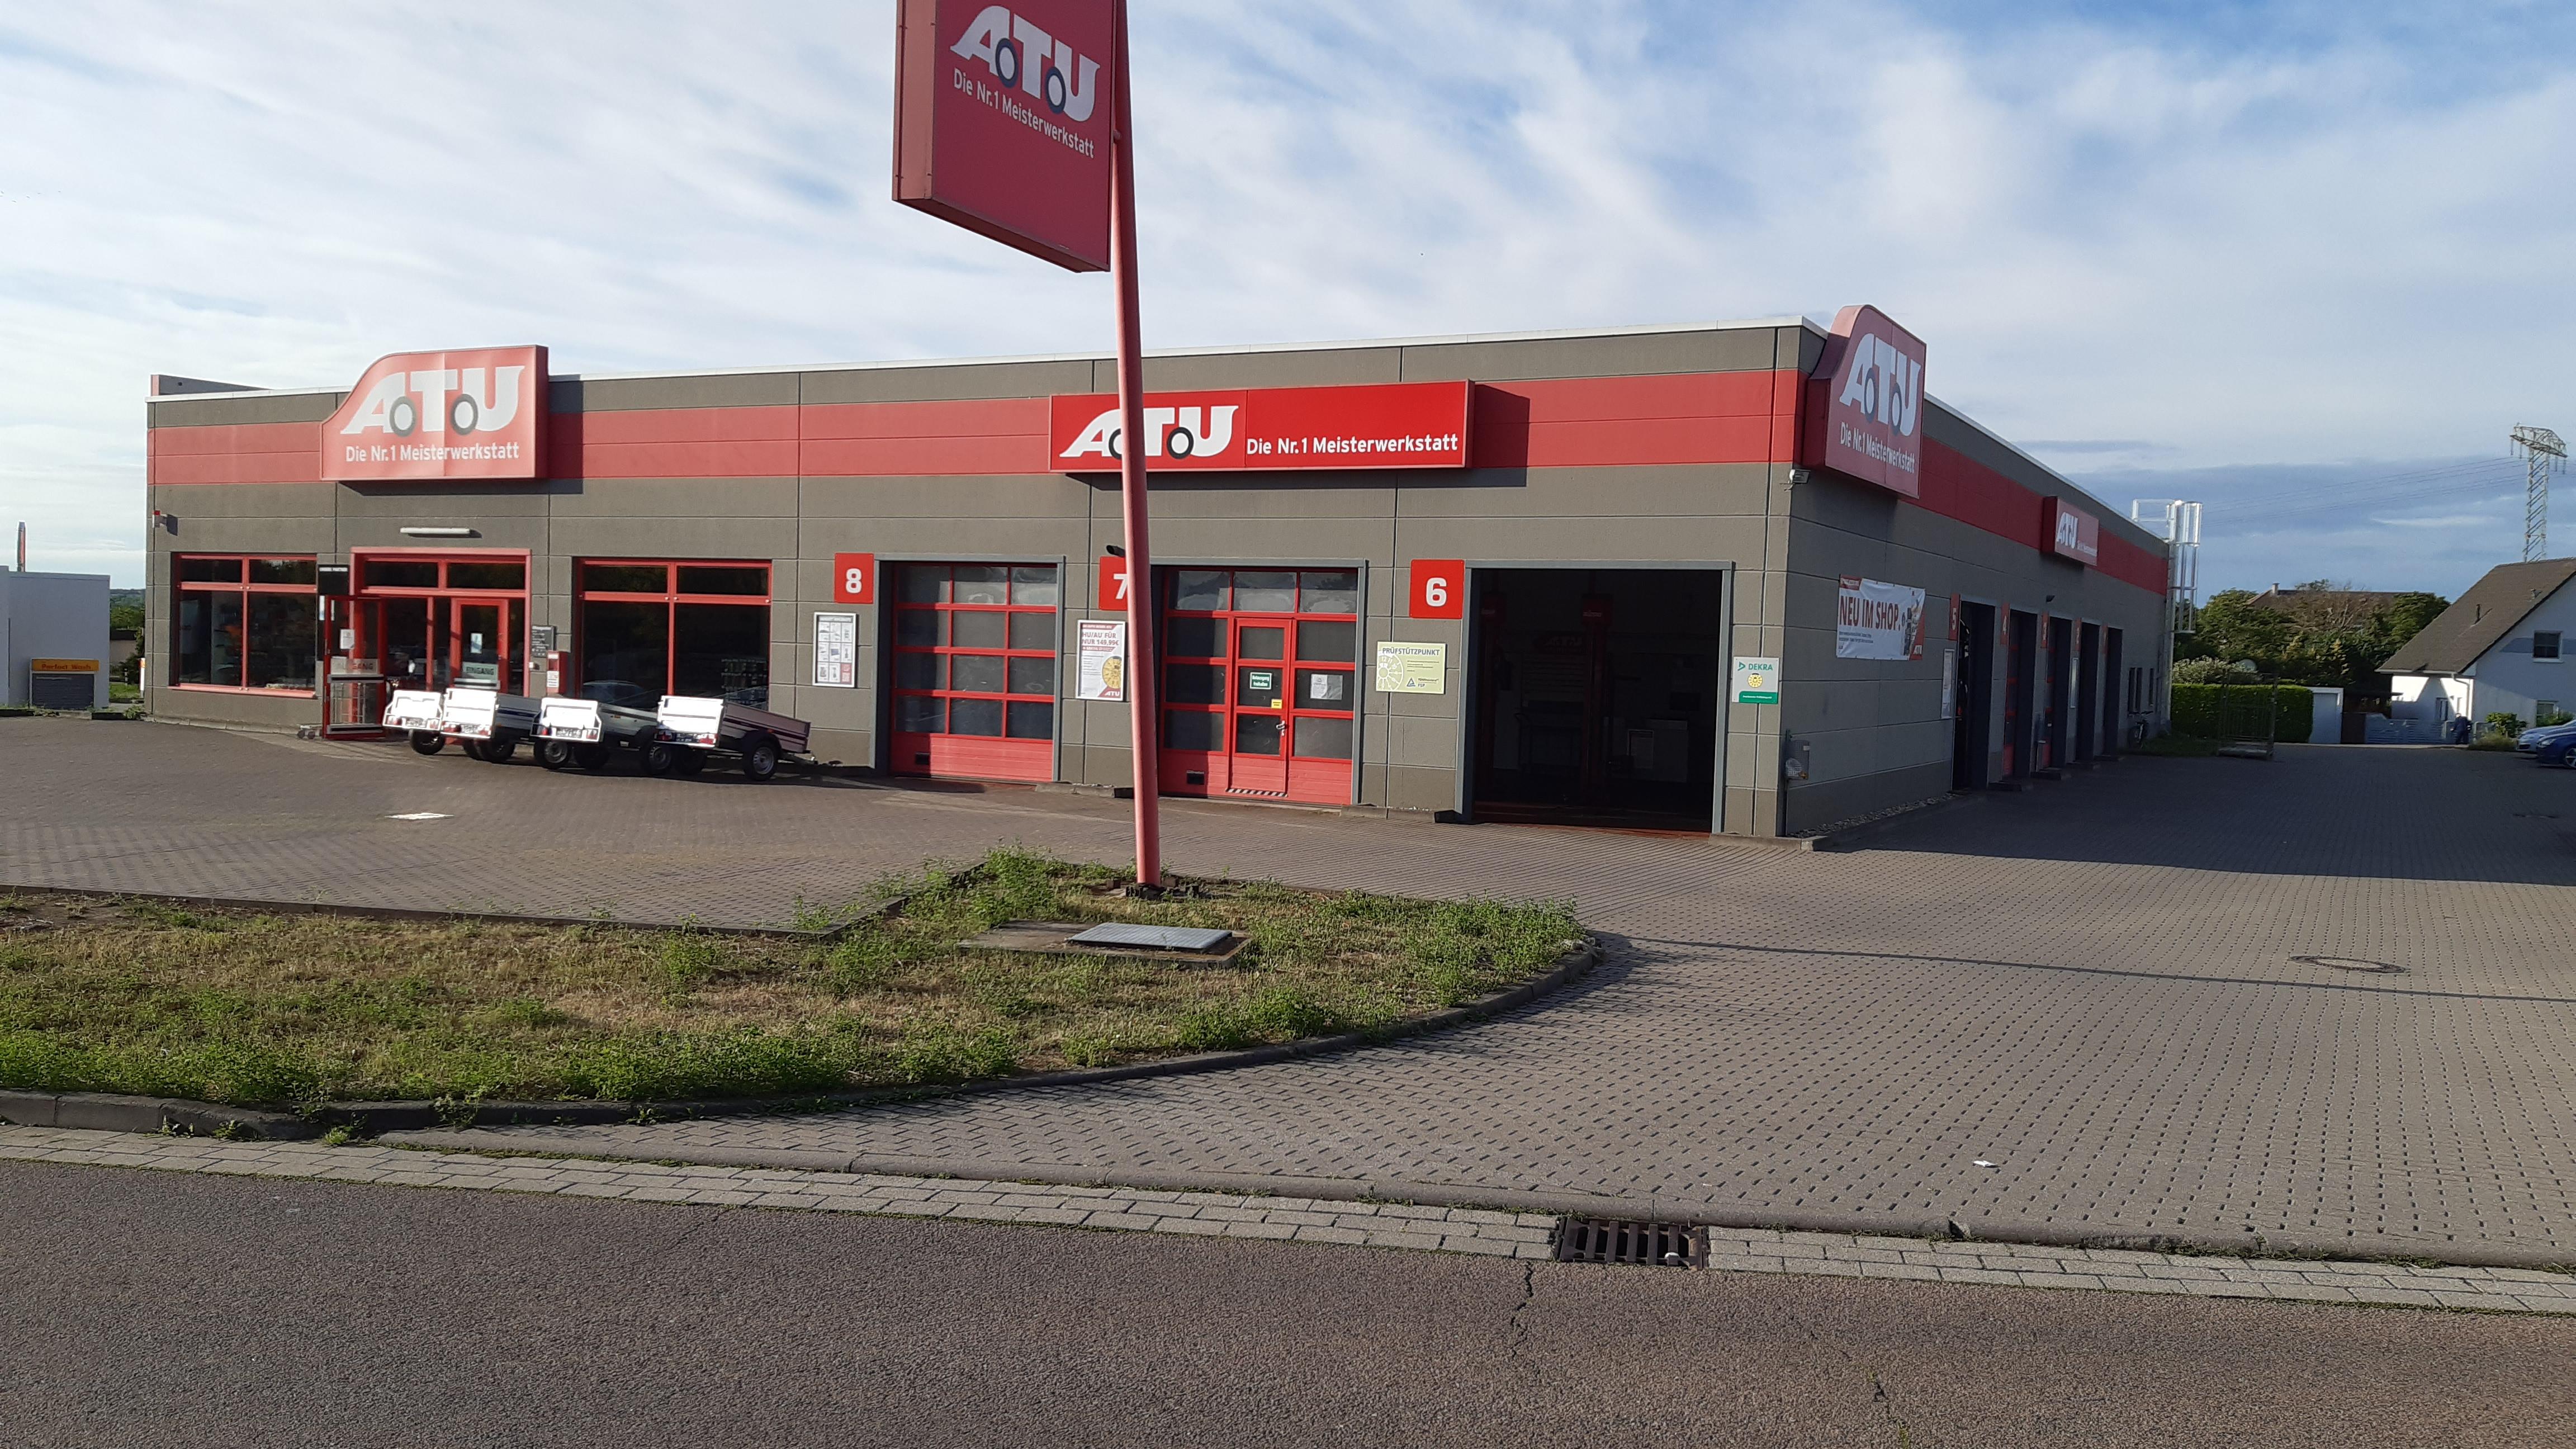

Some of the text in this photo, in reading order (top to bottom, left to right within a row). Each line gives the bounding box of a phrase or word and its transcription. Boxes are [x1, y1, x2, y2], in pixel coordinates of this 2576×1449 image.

[950, 6, 1100, 121] ATU
[954, 67, 973, 96] Die
[1002, 94, 1094, 159] Meisterwerkstatt
[1839, 333, 1921, 436] ATU
[340, 366, 525, 437] ATU
[345, 446, 367, 462] Die
[400, 442, 519, 461] Meisterwerkstatt
[1247, 438, 1271, 454] Die
[1313, 433, 1458, 453] Meisterwerkstatt
[1840, 422, 1851, 447] Die
[1866, 433, 1915, 473] Meisterwerkstatt
[846, 568, 862, 593] 8
[1113, 573, 1128, 599] 7
[1426, 577, 1447, 607] 6
[1839, 595, 1900, 631] NEU IM SHOP.
[1952, 608, 1957, 630] 5
[2002, 615, 2007, 635] 4
[1382, 647, 1440, 655] PRÜFSTÜTZPUNKT
